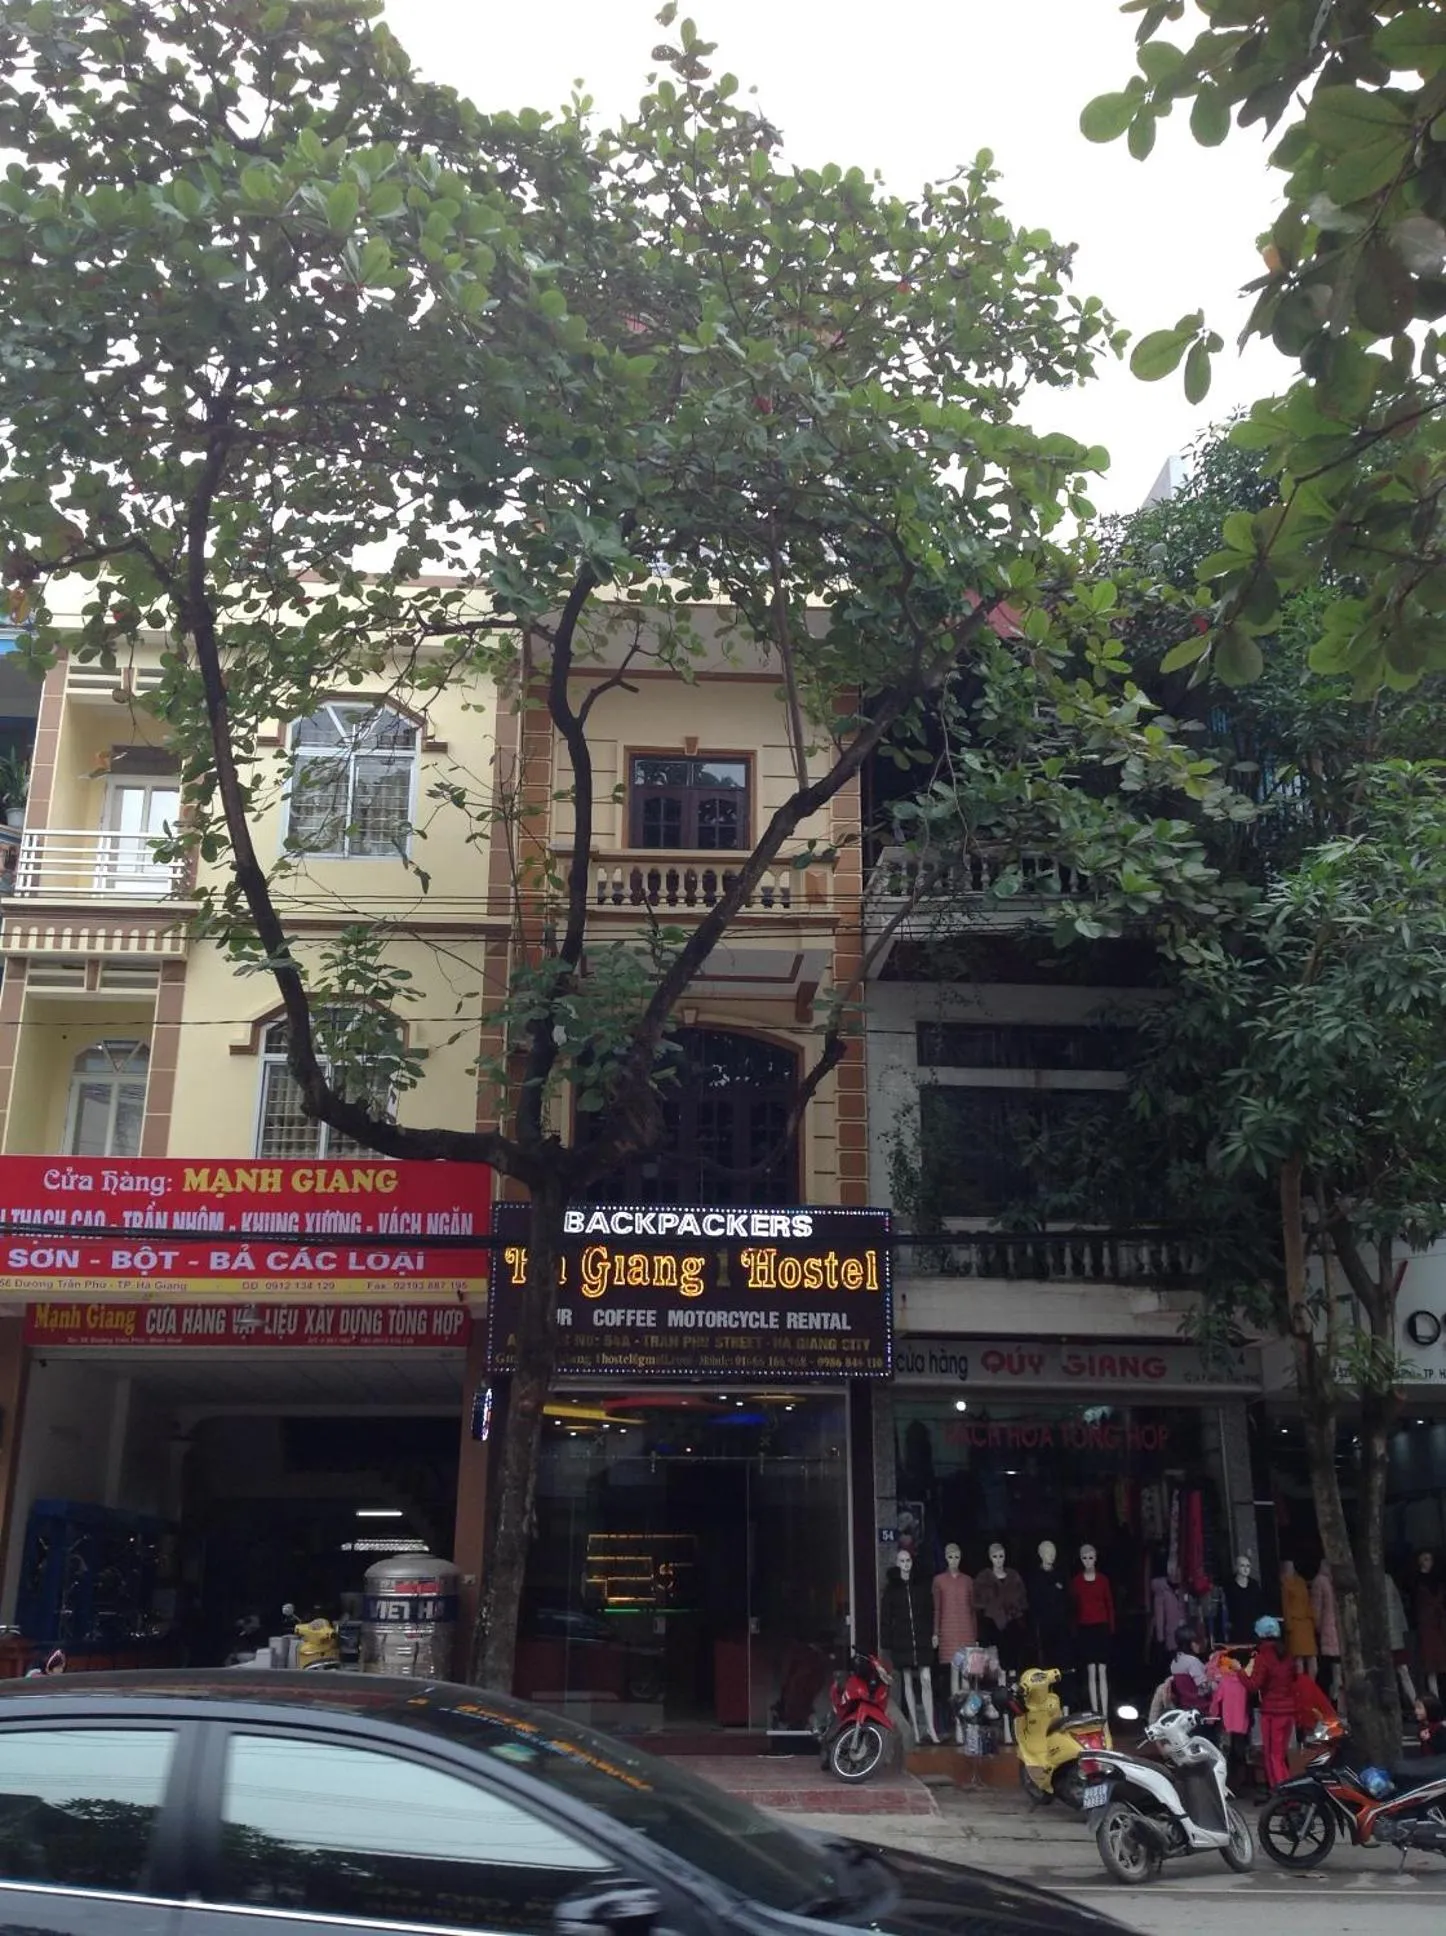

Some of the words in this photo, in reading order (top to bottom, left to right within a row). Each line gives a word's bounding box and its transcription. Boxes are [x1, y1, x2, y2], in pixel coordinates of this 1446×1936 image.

[43, 1166, 93, 1191] Cửa
[182, 1167, 282, 1198] MẠNH
[291, 1168, 398, 1193] GIANG
[564, 1210, 813, 1238] BACKPACKERS
[7, 1248, 80, 1268] SƠN
[111, 1246, 180, 1276] BỘT
[209, 1245, 256, 1270] BẢ
[266, 1247, 337, 1271] CÁC
[348, 1251, 425, 1276] LOẠI
[581, 1245, 705, 1298] Giang
[741, 1247, 879, 1290] Hostel
[593, 1309, 657, 1327] COFFEE
[668, 1310, 780, 1329] MOTORCYCLE
[787, 1312, 852, 1330] RENTAL
[929, 1348, 968, 1381] hàng
[1062, 1354, 1167, 1380] GIANG
